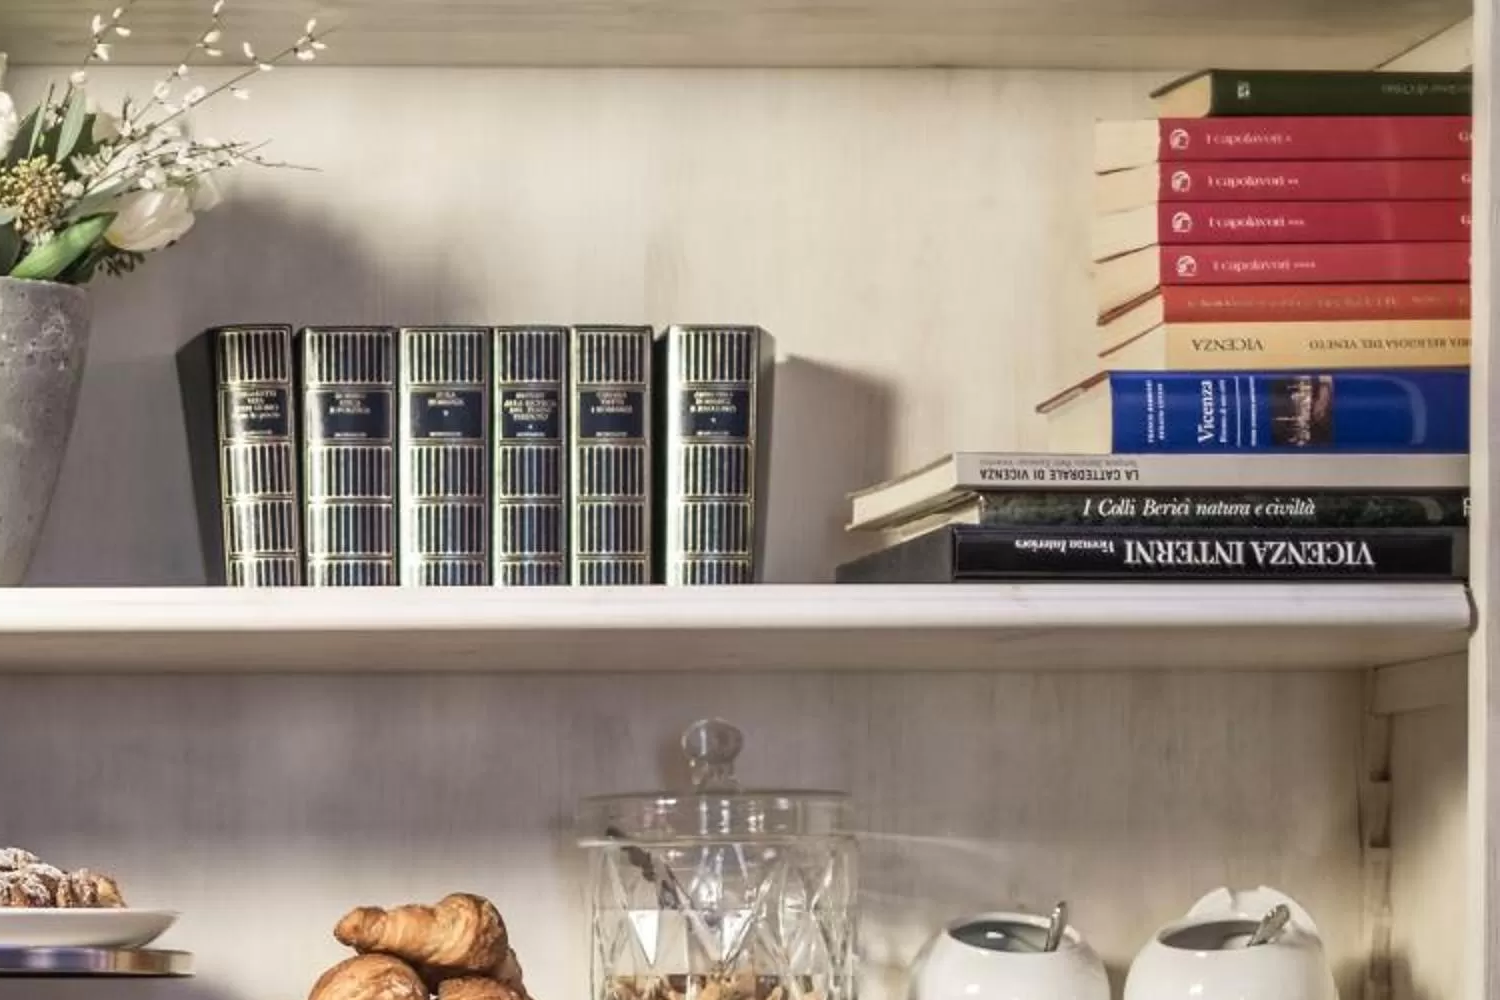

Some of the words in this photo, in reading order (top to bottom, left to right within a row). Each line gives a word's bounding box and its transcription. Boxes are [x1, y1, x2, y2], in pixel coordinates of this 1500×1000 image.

[1214, 132, 1282, 145] capolavori
[1215, 175, 1285, 188] capolavori
[1216, 215, 1285, 229] capolavori
[1220, 259, 1290, 272] capolavori
[1192, 339, 1265, 351] VICENZA
[1309, 339, 1358, 350] VENETO
[1363, 339, 1383, 350] DEL
[1197, 380, 1215, 443] Vicenza
[980, 468, 1029, 480] VICENZA
[1033, 469, 1045, 480] DI
[1050, 469, 1121, 480] CATTEDRALE
[1125, 469, 1139, 480] LA
[1083, 498, 1092, 516] I
[1098, 498, 1137, 516] Colli
[1143, 498, 1191, 516] Berici
[1195, 501, 1251, 516] natura
[1254, 505, 1263, 516] e
[1265, 497, 1317, 516] civiltà
[1015, 540, 1067, 553] Interiors
[1068, 539, 1115, 554] Vicenza
[1124, 539, 1244, 565] INTERNI
[1251, 540, 1375, 566] VICENZA
